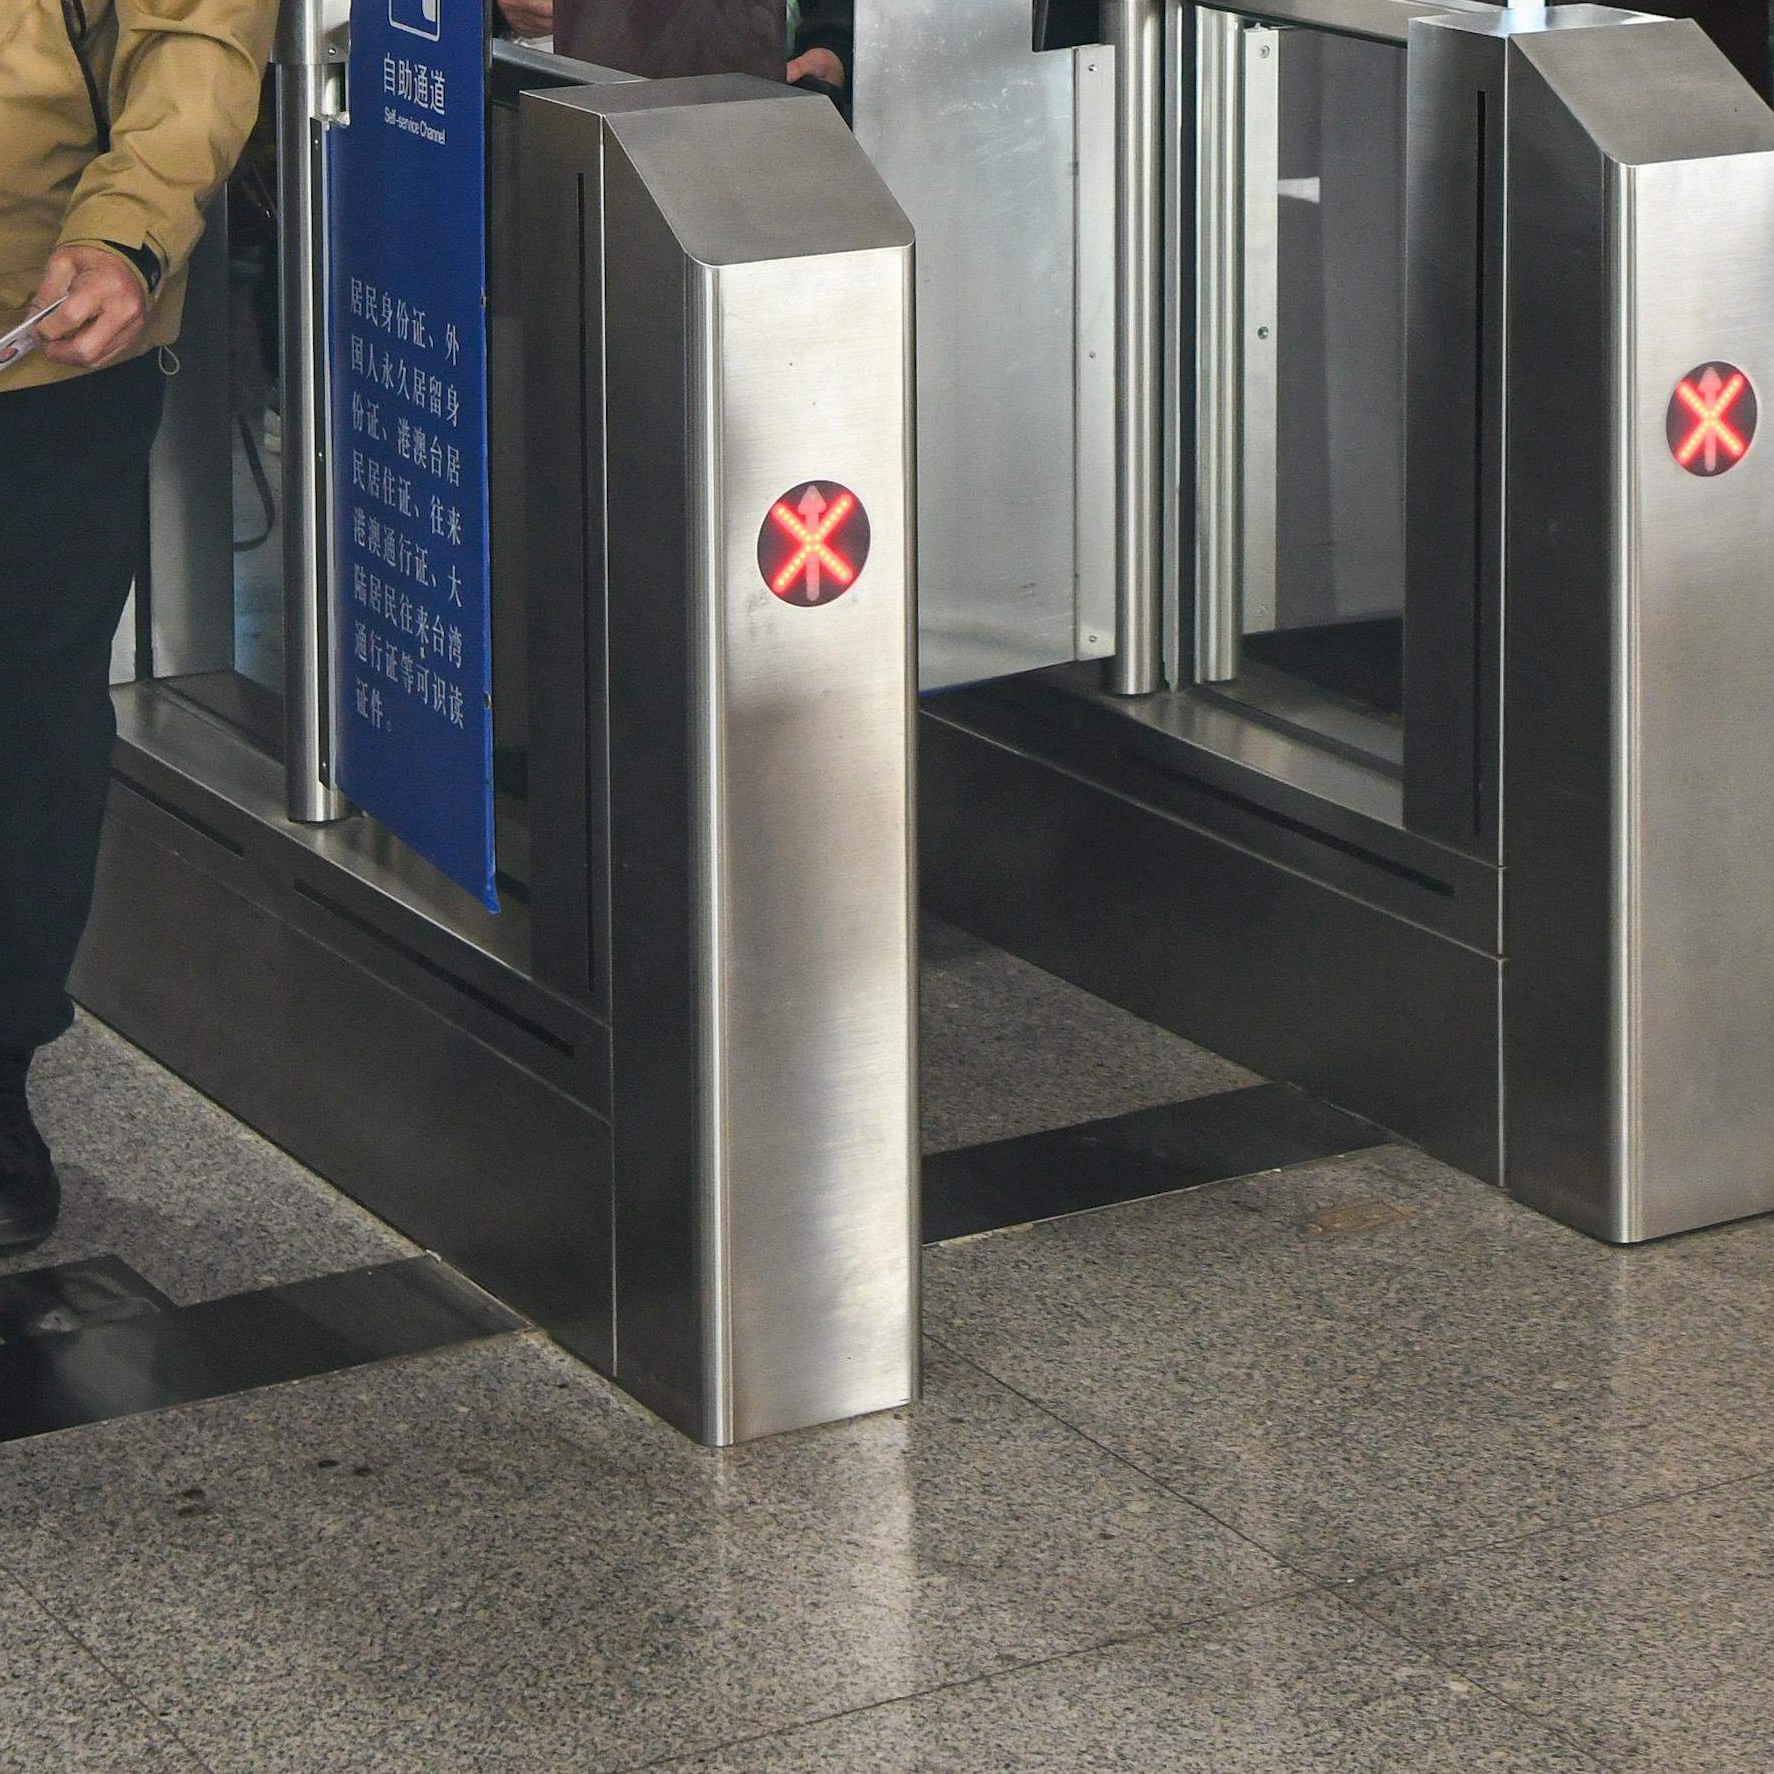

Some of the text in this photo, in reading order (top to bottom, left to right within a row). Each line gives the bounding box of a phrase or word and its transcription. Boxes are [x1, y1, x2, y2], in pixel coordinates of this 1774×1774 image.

[383, 52, 446, 116] 自助通道
[384, 106, 446, 145] Self-service Channel
[350, 276, 461, 365] 居民身份证、外
[351, 334, 461, 427] 国人永久居留身
[352, 392, 462, 486] 份证、港澳台居
[352, 449, 462, 546] 民居住证、往来
[353, 506, 463, 608] 港澳通行证、大
[354, 564, 463, 670] 陆居民往来台湾
[355, 622, 465, 730] 通行证等可识读
[356, 680, 394, 732] 证件。
